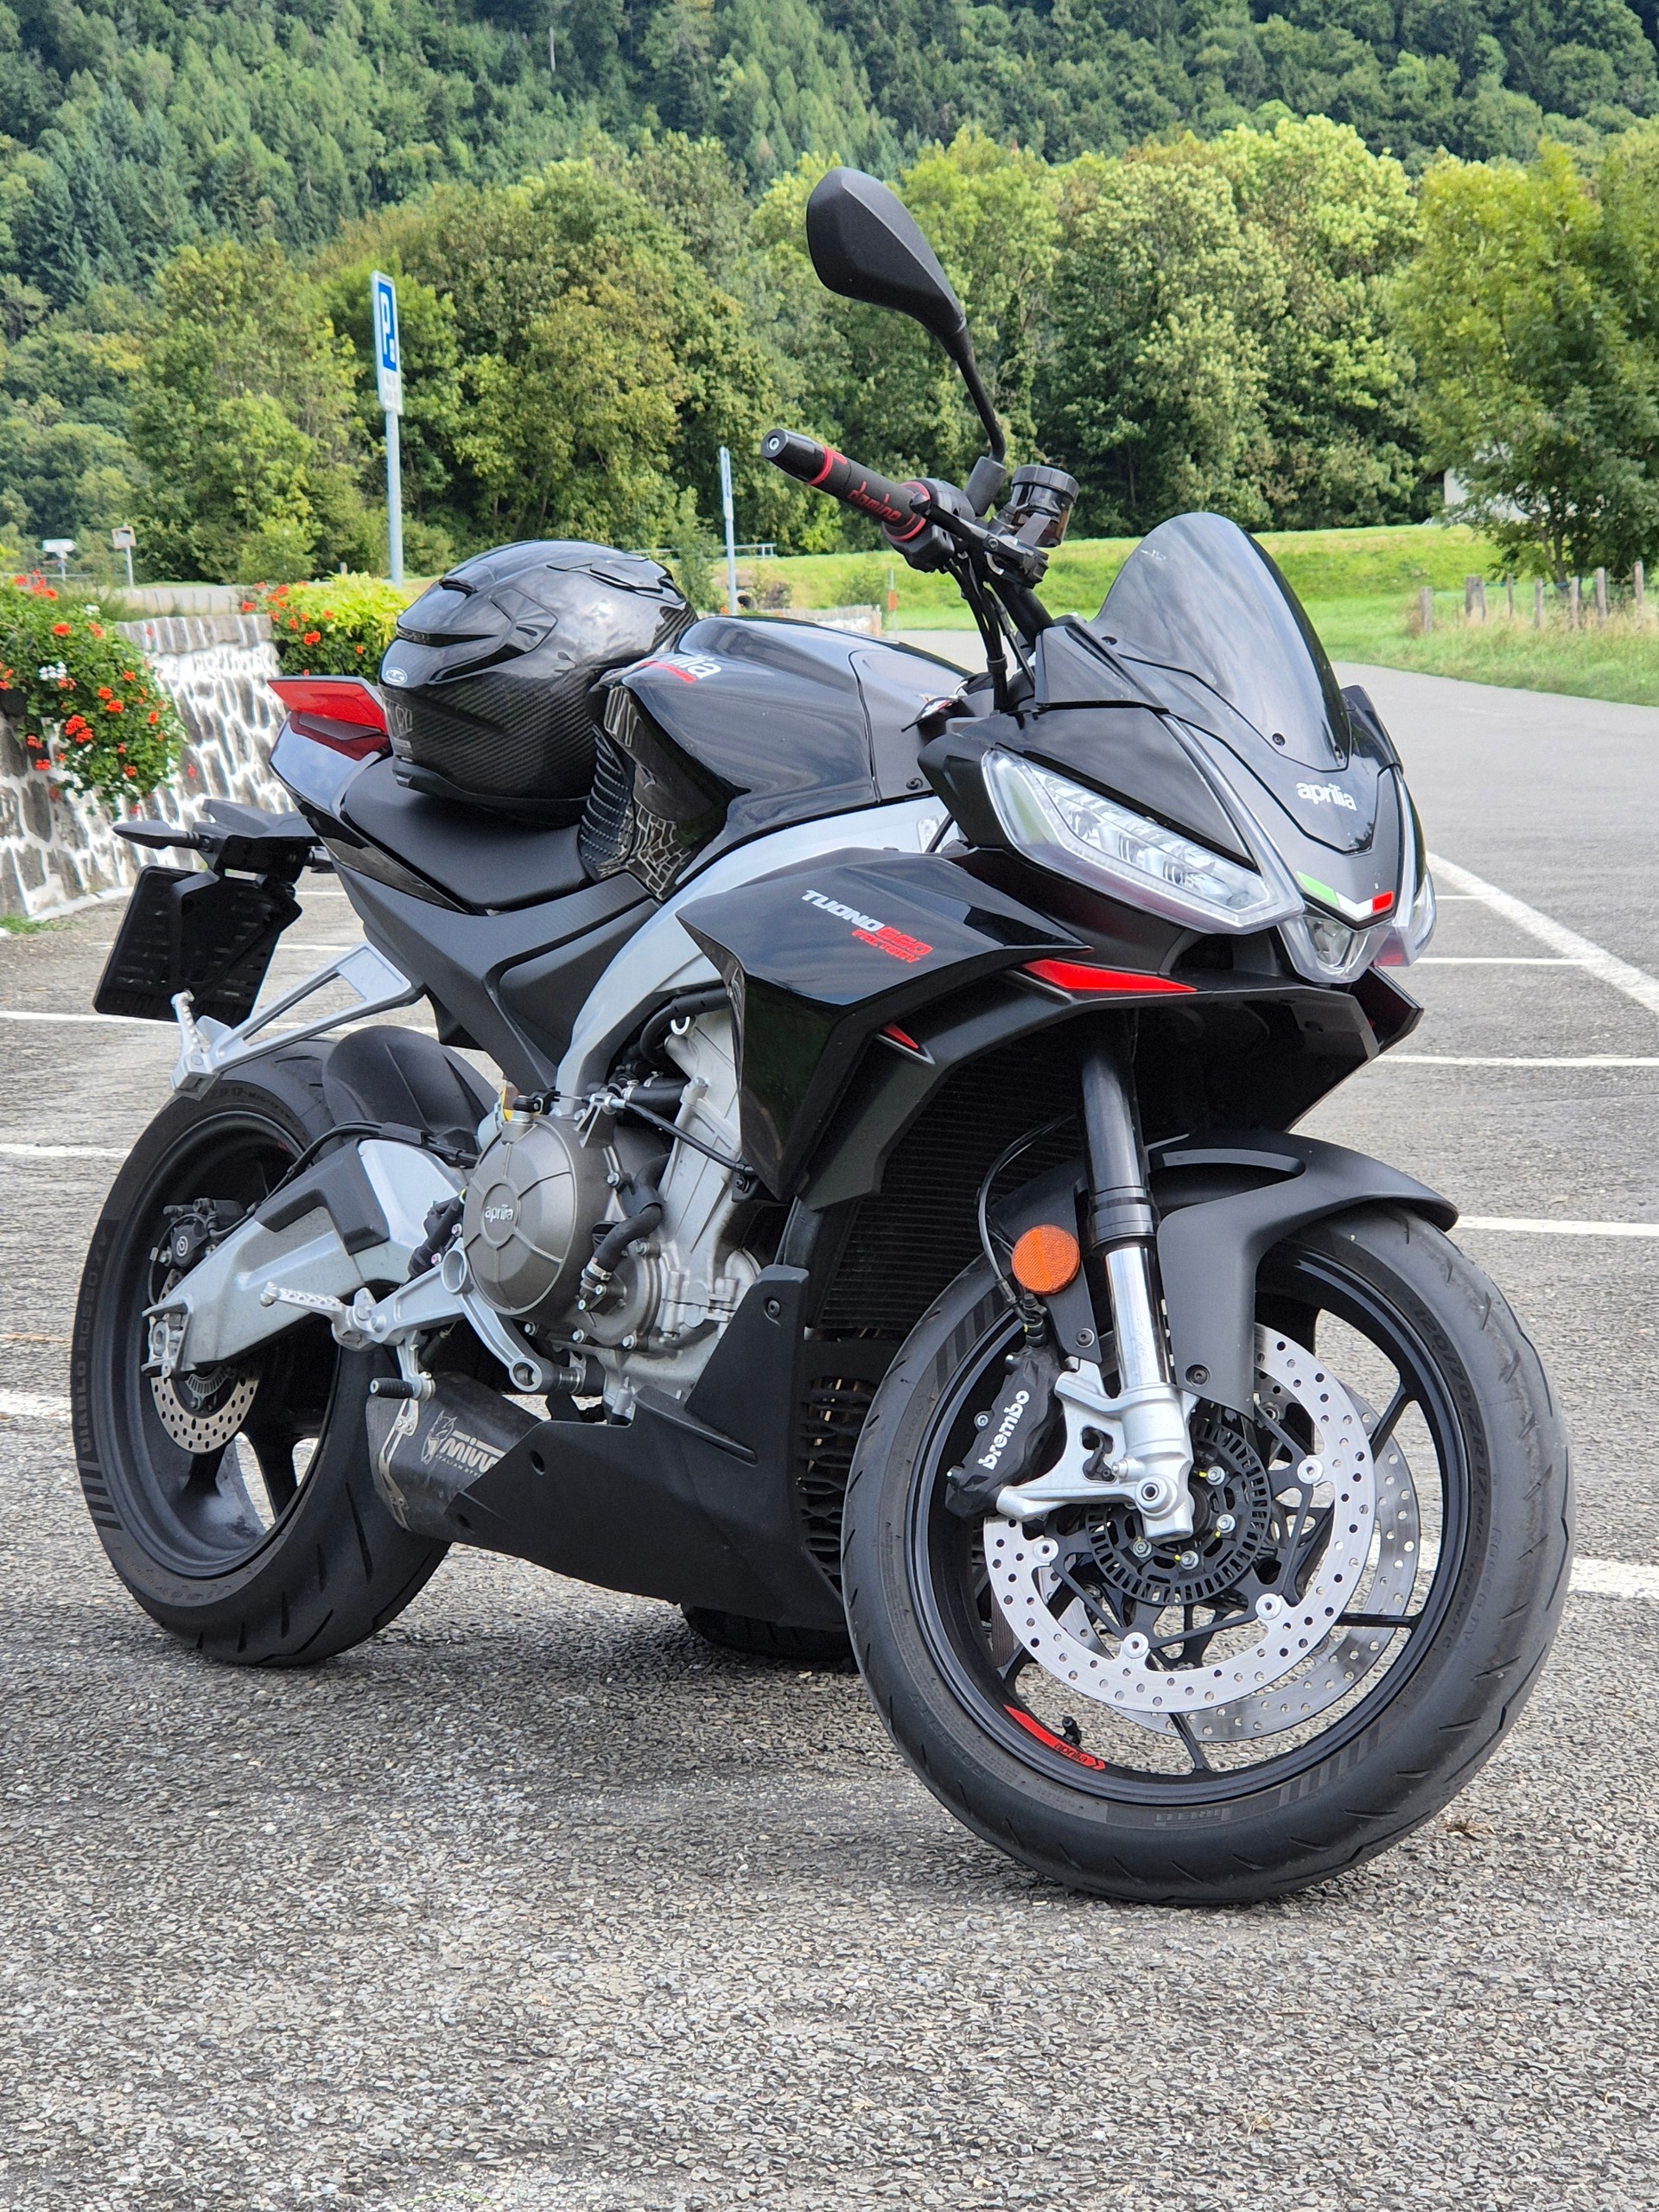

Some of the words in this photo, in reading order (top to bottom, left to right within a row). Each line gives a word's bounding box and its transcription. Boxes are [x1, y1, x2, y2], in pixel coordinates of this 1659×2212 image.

[380, 292, 391, 355] P
[848, 481, 901, 521] domino
[1296, 781, 1357, 811] aprilia
[802, 889, 886, 932] TUONO
[875, 926, 933, 956] 660
[851, 928, 920, 963] FACTORY
[484, 1204, 513, 1222] aprilia
[78, 1270, 99, 1352] ROSSO
[75, 1359, 92, 1455] DIABLO
[977, 1389, 1030, 1471] brembo
[1052, 1742, 1089, 1764] aprilia
